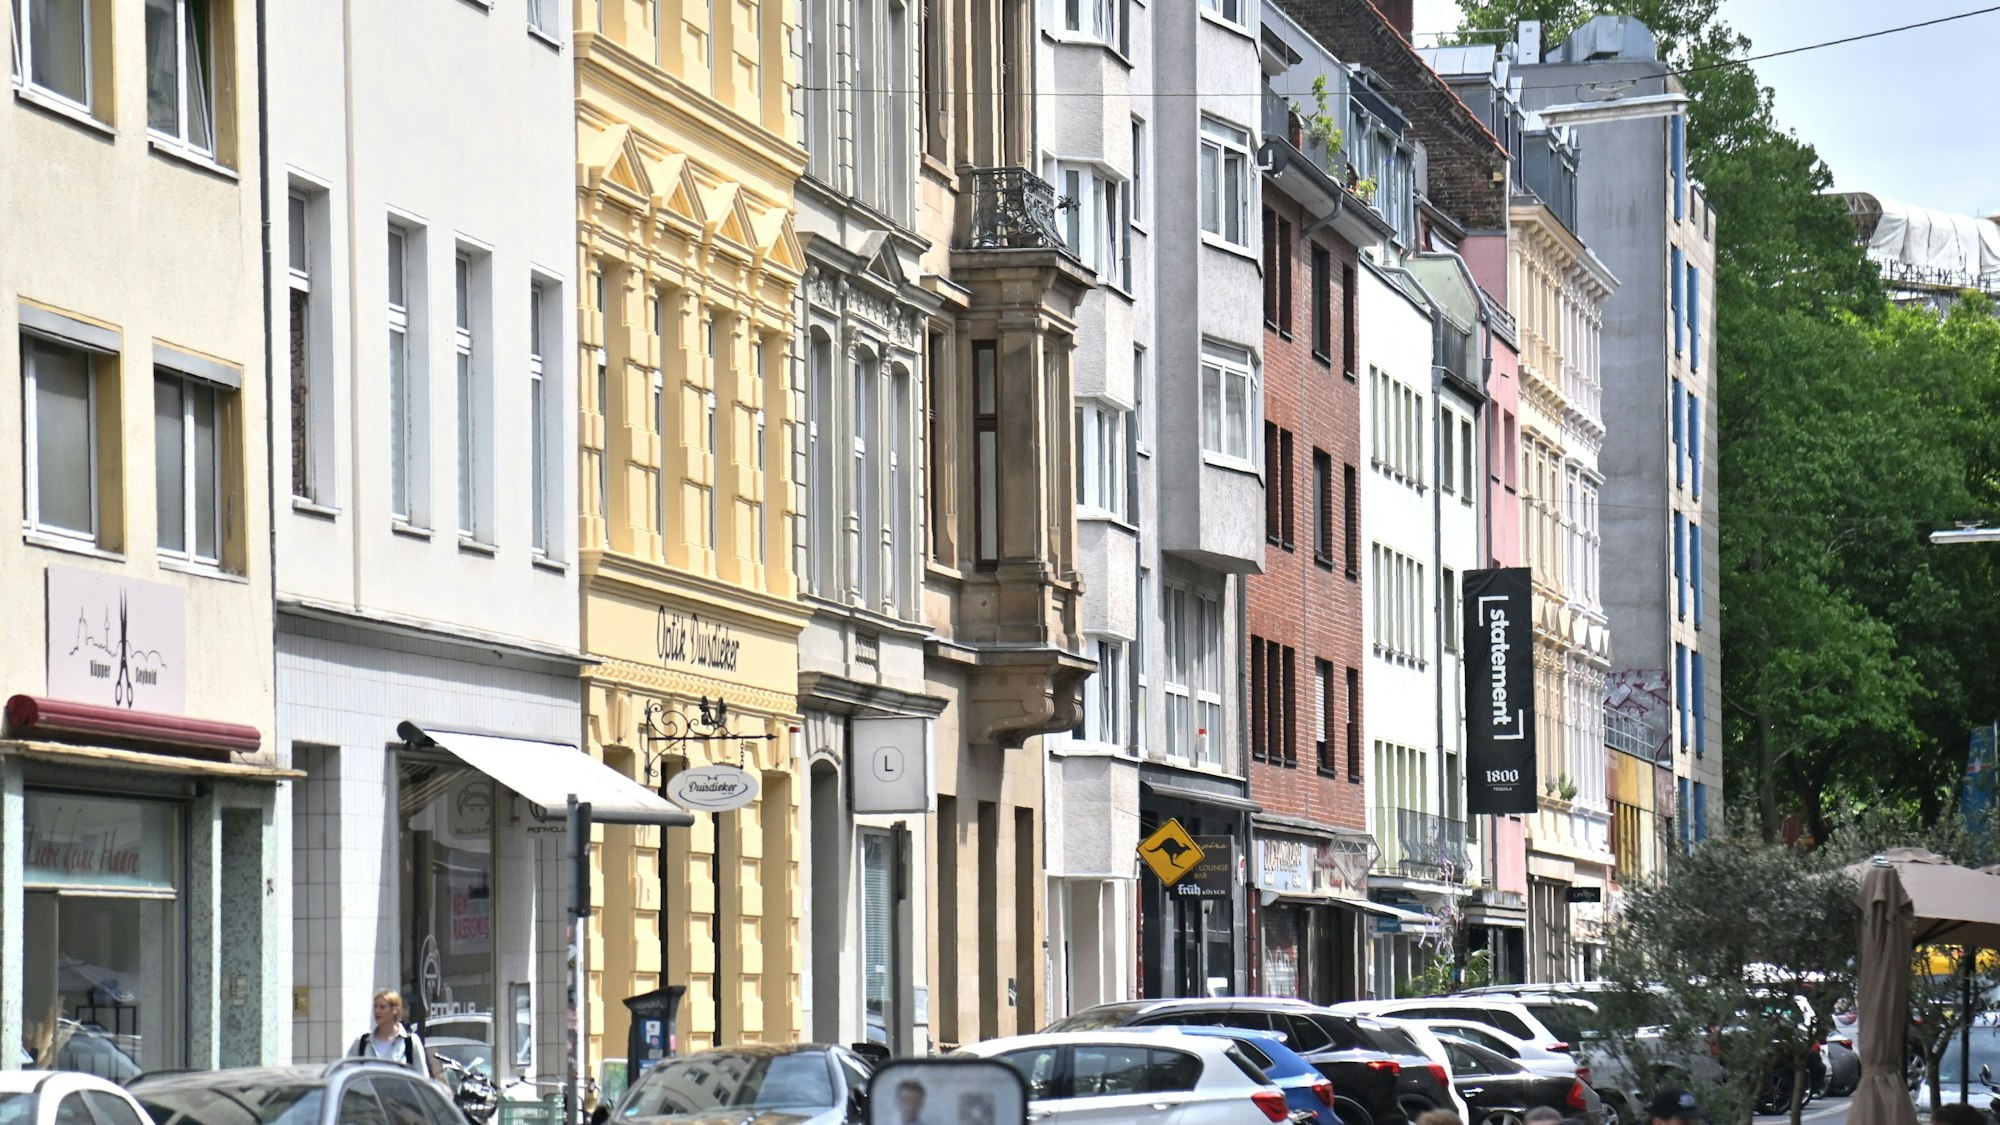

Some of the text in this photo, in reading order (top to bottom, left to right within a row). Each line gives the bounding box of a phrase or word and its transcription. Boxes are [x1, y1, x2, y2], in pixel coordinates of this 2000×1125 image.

[657, 605, 739, 673] Optik Duisdieker
[1490, 609, 1512, 726] statement
[884, 755, 895, 772] L
[1485, 769, 1519, 783] 1800
[688, 781, 738, 793] Duisdieker
[527, 826, 568, 834] PONYCLU
[1200, 864, 1230, 873] LOUNGE
[1193, 872, 1209, 880] BAR
[1177, 883, 1202, 897] früh
